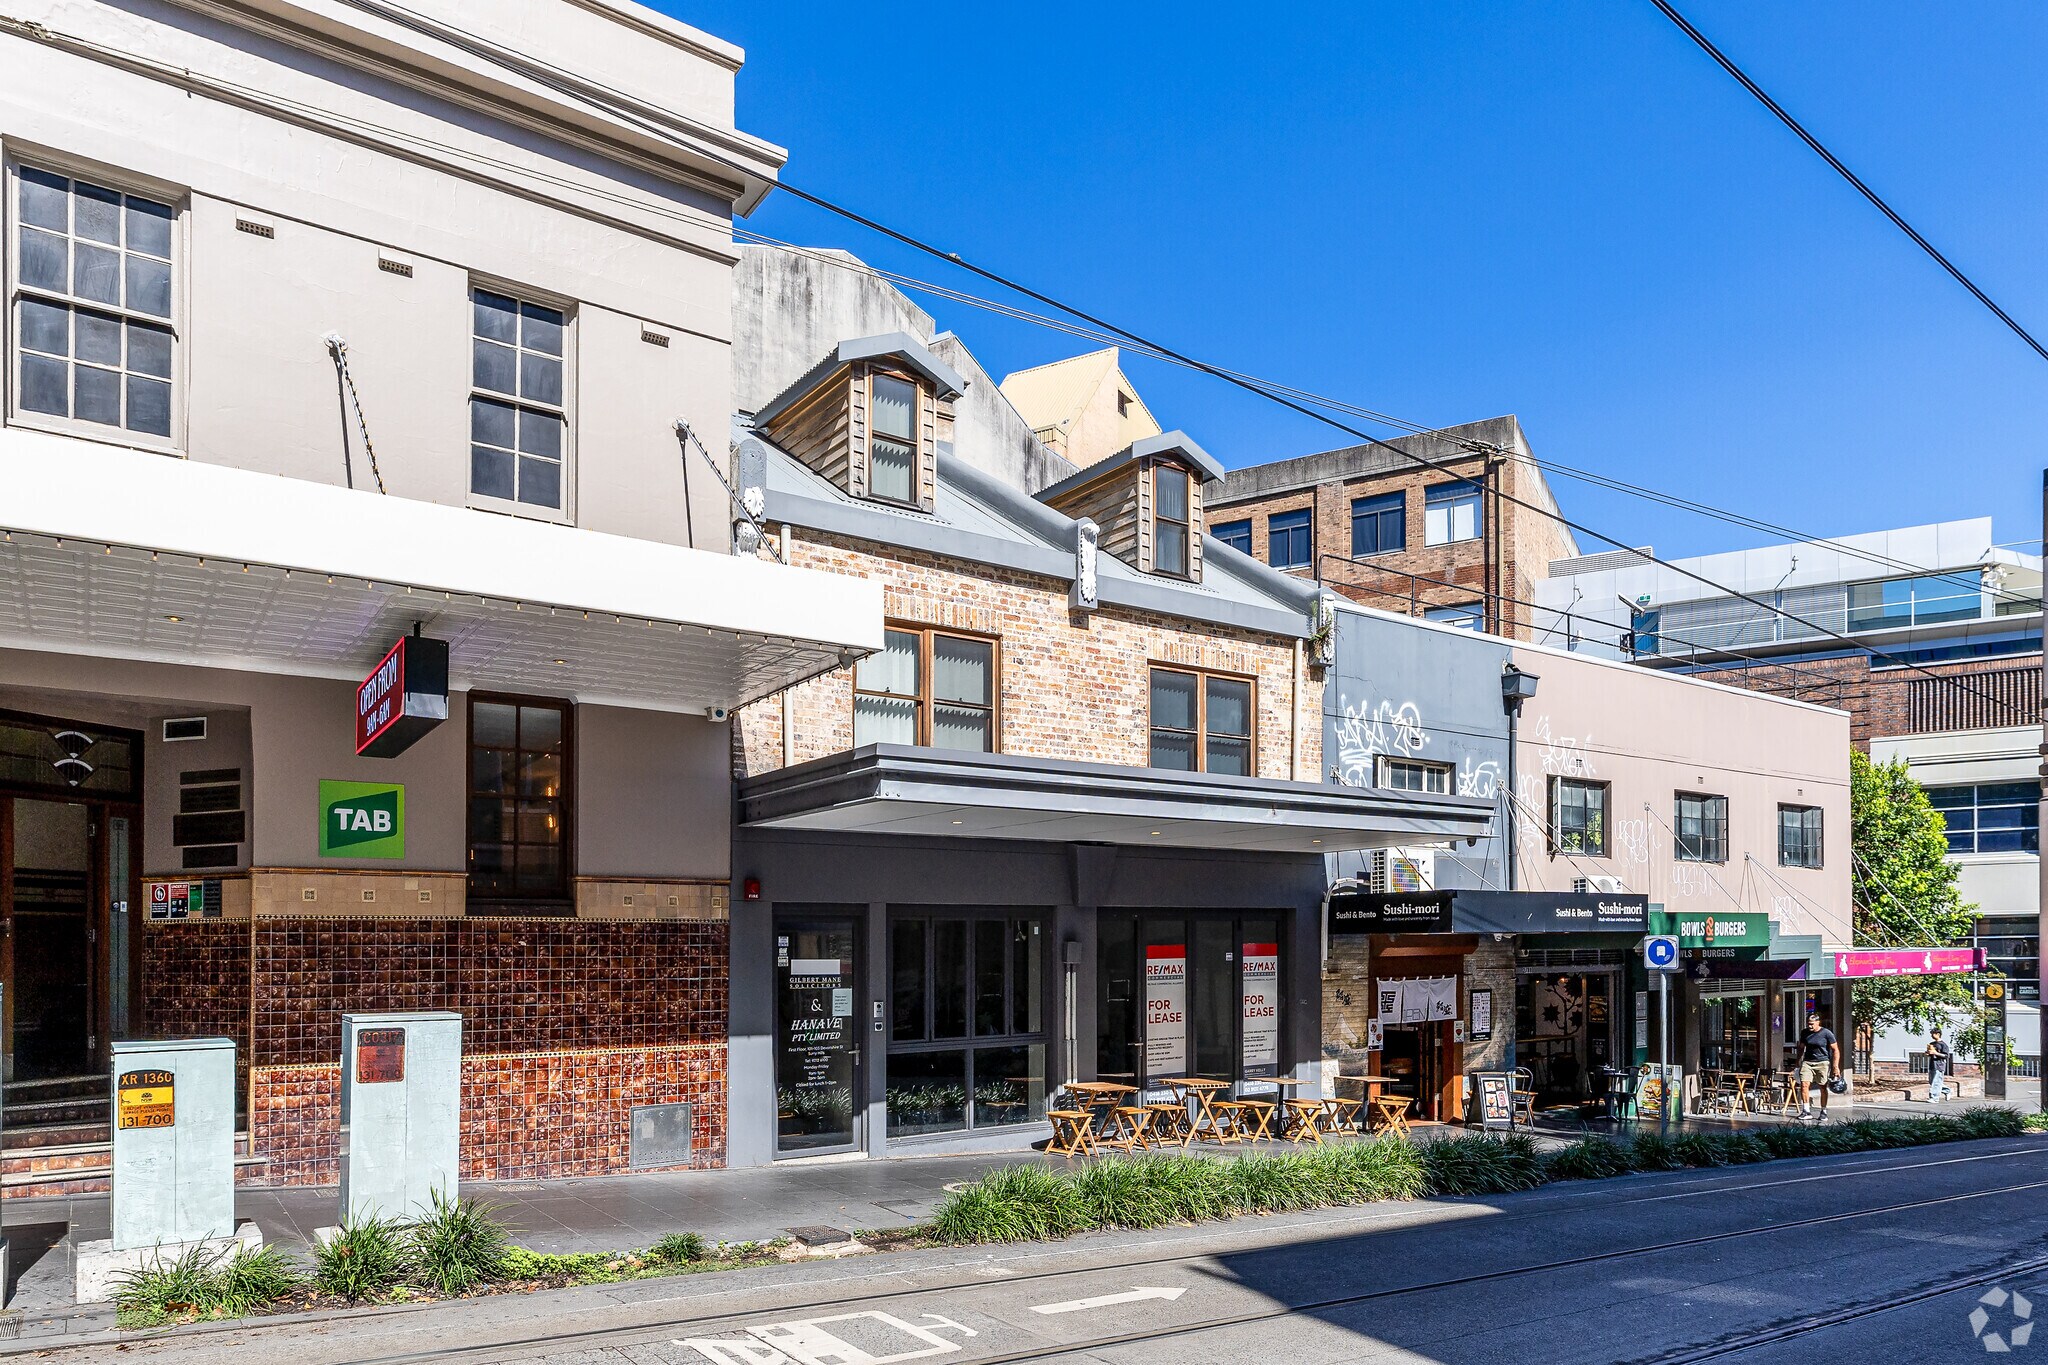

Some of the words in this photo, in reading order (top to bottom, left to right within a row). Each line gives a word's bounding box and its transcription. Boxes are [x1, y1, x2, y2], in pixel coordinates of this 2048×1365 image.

[360, 675, 377, 716] OPEN
[377, 653, 398, 699] FROM
[334, 808, 392, 832] TAB
[1383, 903, 1440, 915] Sushi-mori
[1556, 908, 1570, 917] Sushi
[1571, 908, 1576, 917] &
[1577, 908, 1593, 917] Bento
[1598, 902, 1642, 914] Sushi-mori
[1336, 911, 1352, 919] Sushi
[1681, 922, 1706, 936] BOWLS
[1706, 916, 1714, 938] &
[1714, 921, 1746, 936] BURGERS
[1702, 949, 1735, 957] BURGERS
[1147, 965, 1184, 975] RE/MAX
[1243, 962, 1276, 971] RE/MAX
[811, 999, 823, 1012] &
[1148, 1000, 1170, 1010] FOR
[1244, 995, 1264, 1005] FOR
[1244, 1007, 1274, 1017] LEASE
[1148, 1012, 1182, 1024] LEASE
[792, 1032, 810, 1042] PTY
[809, 1032, 840, 1040] LIMITED
[122, 1074, 138, 1085] XR
[144, 1072, 172, 1084] 1360
[122, 1116, 138, 1127] 131
[144, 1114, 172, 1125] 700
